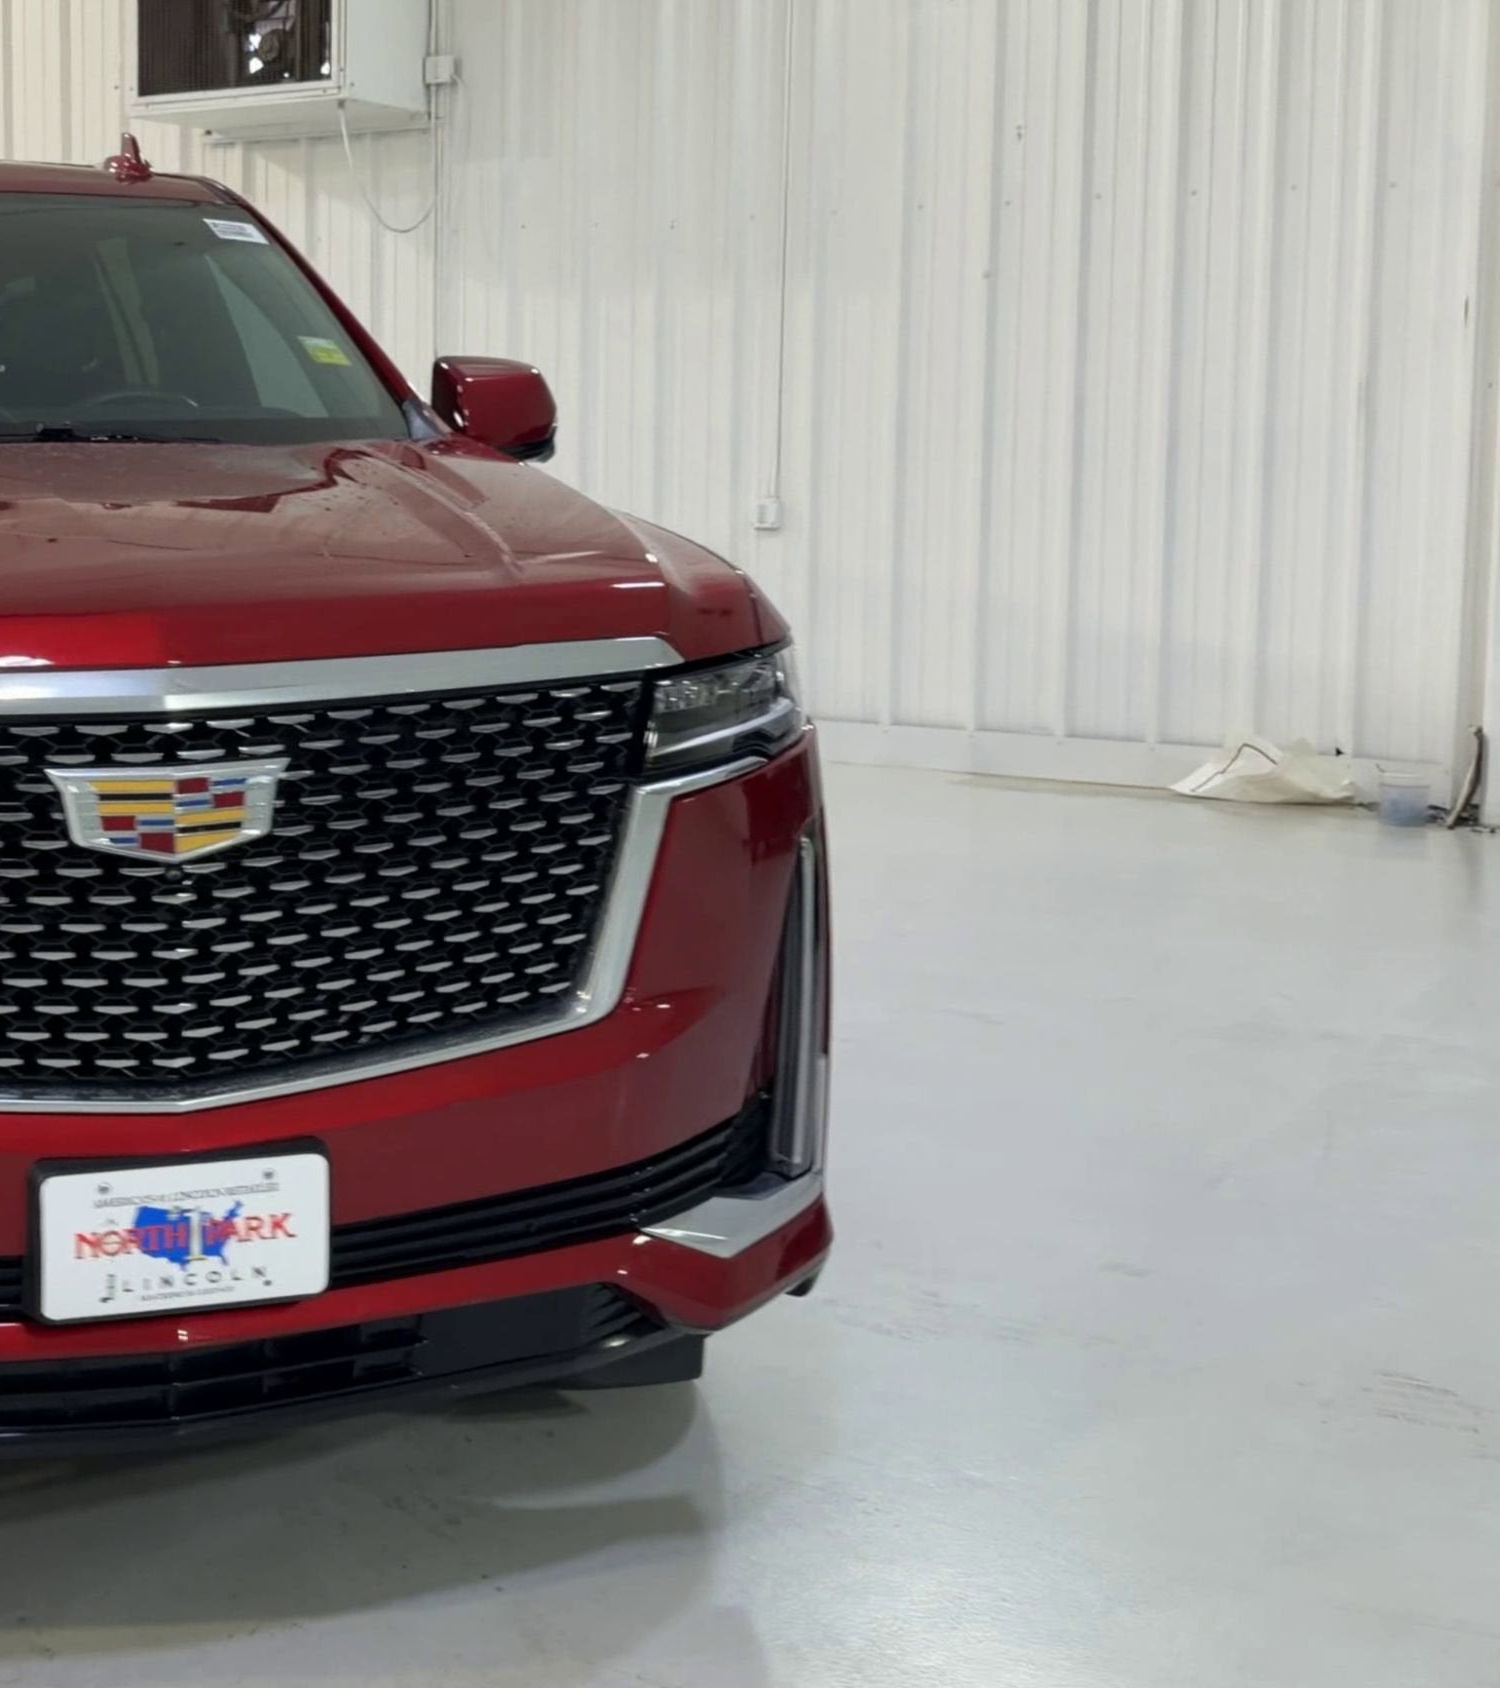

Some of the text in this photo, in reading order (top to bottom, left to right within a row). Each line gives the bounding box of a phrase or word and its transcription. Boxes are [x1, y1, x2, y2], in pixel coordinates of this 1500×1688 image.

[74, 1212, 298, 1260] NORTH PARK
[121, 1265, 267, 1293] LINCOLN
